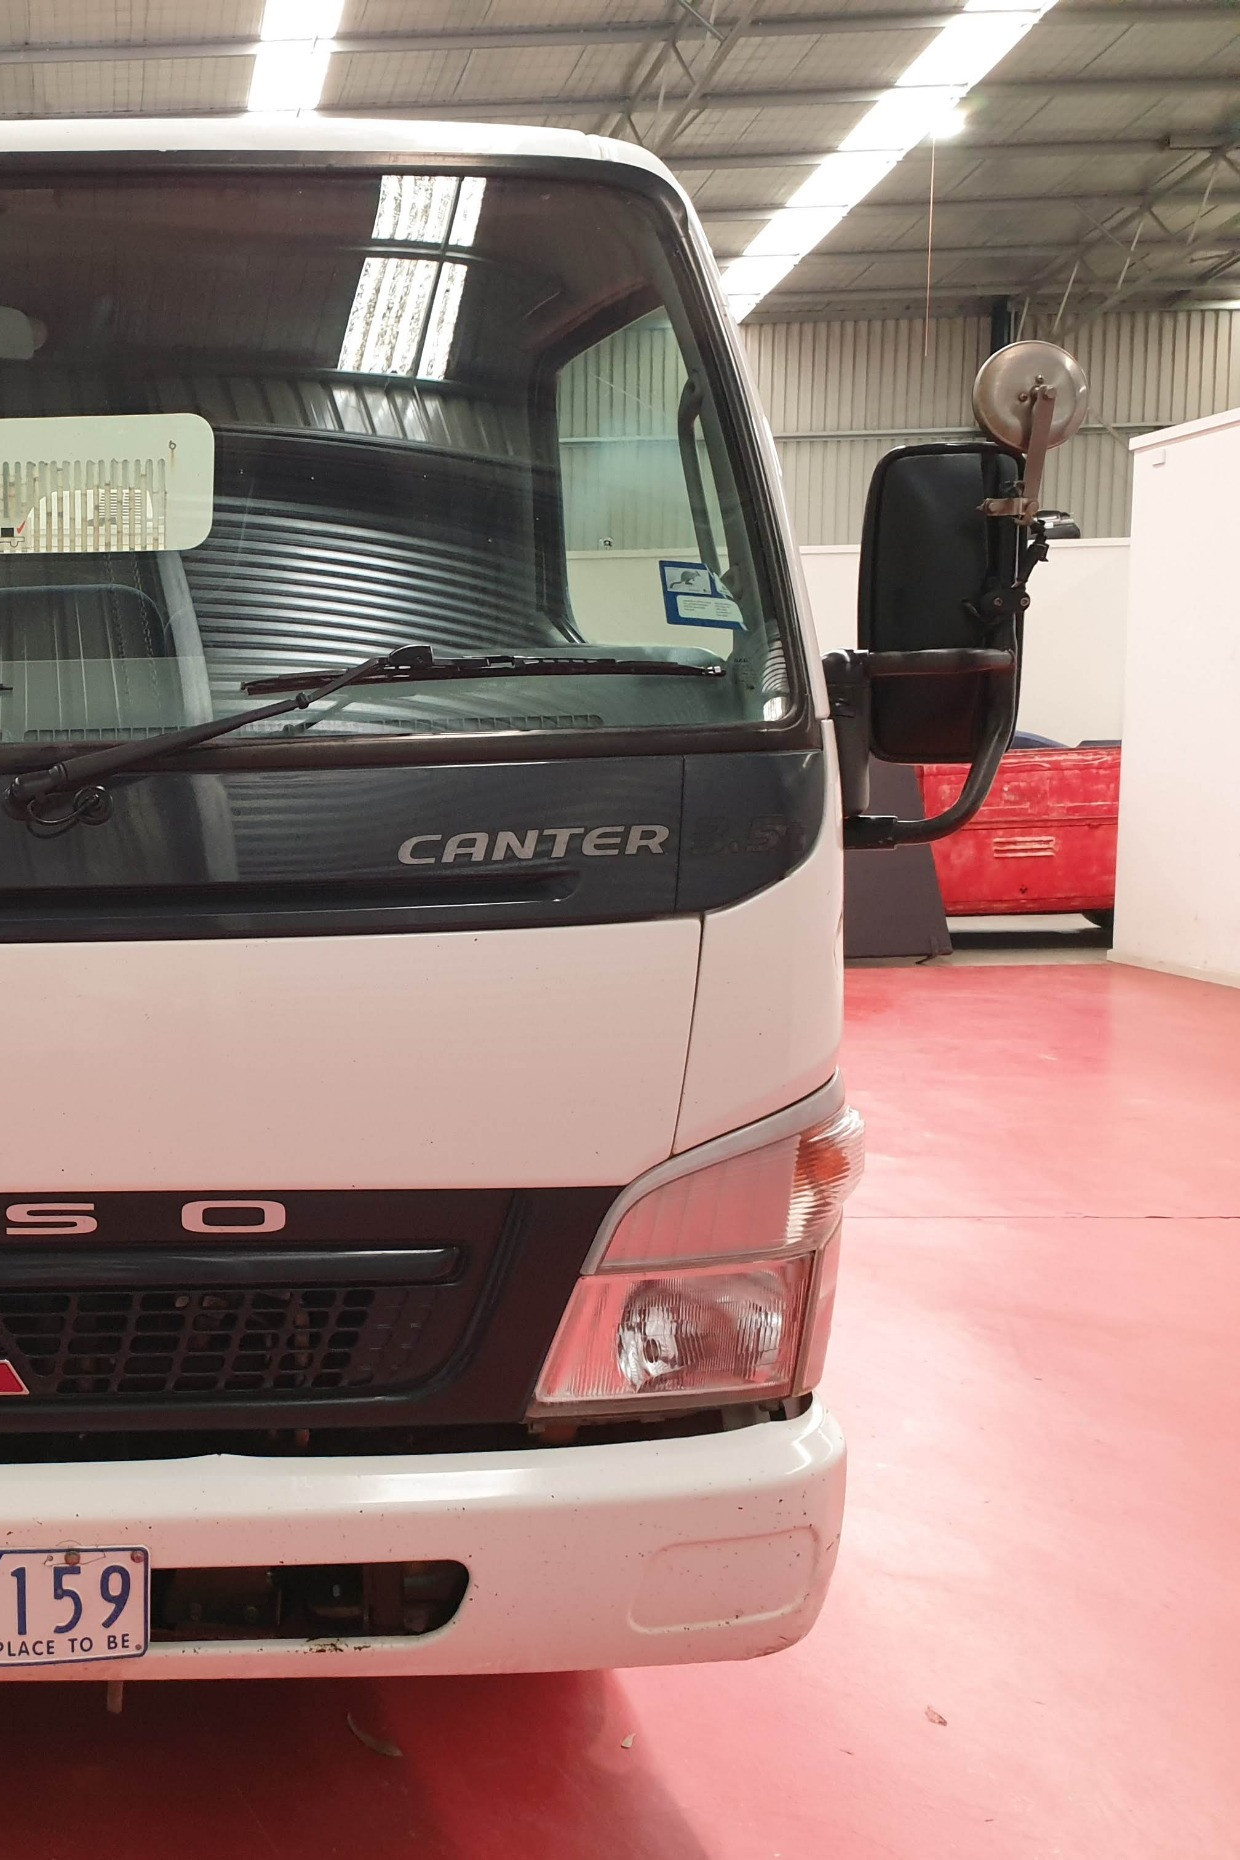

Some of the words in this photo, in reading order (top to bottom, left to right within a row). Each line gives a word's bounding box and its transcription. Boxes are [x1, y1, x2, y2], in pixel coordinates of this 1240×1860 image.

[397, 825, 670, 865] CANTER
[10, 1566, 131, 1635] 159
[68, 1637, 93, 1653] TO
[107, 1634, 130, 1650] BE
